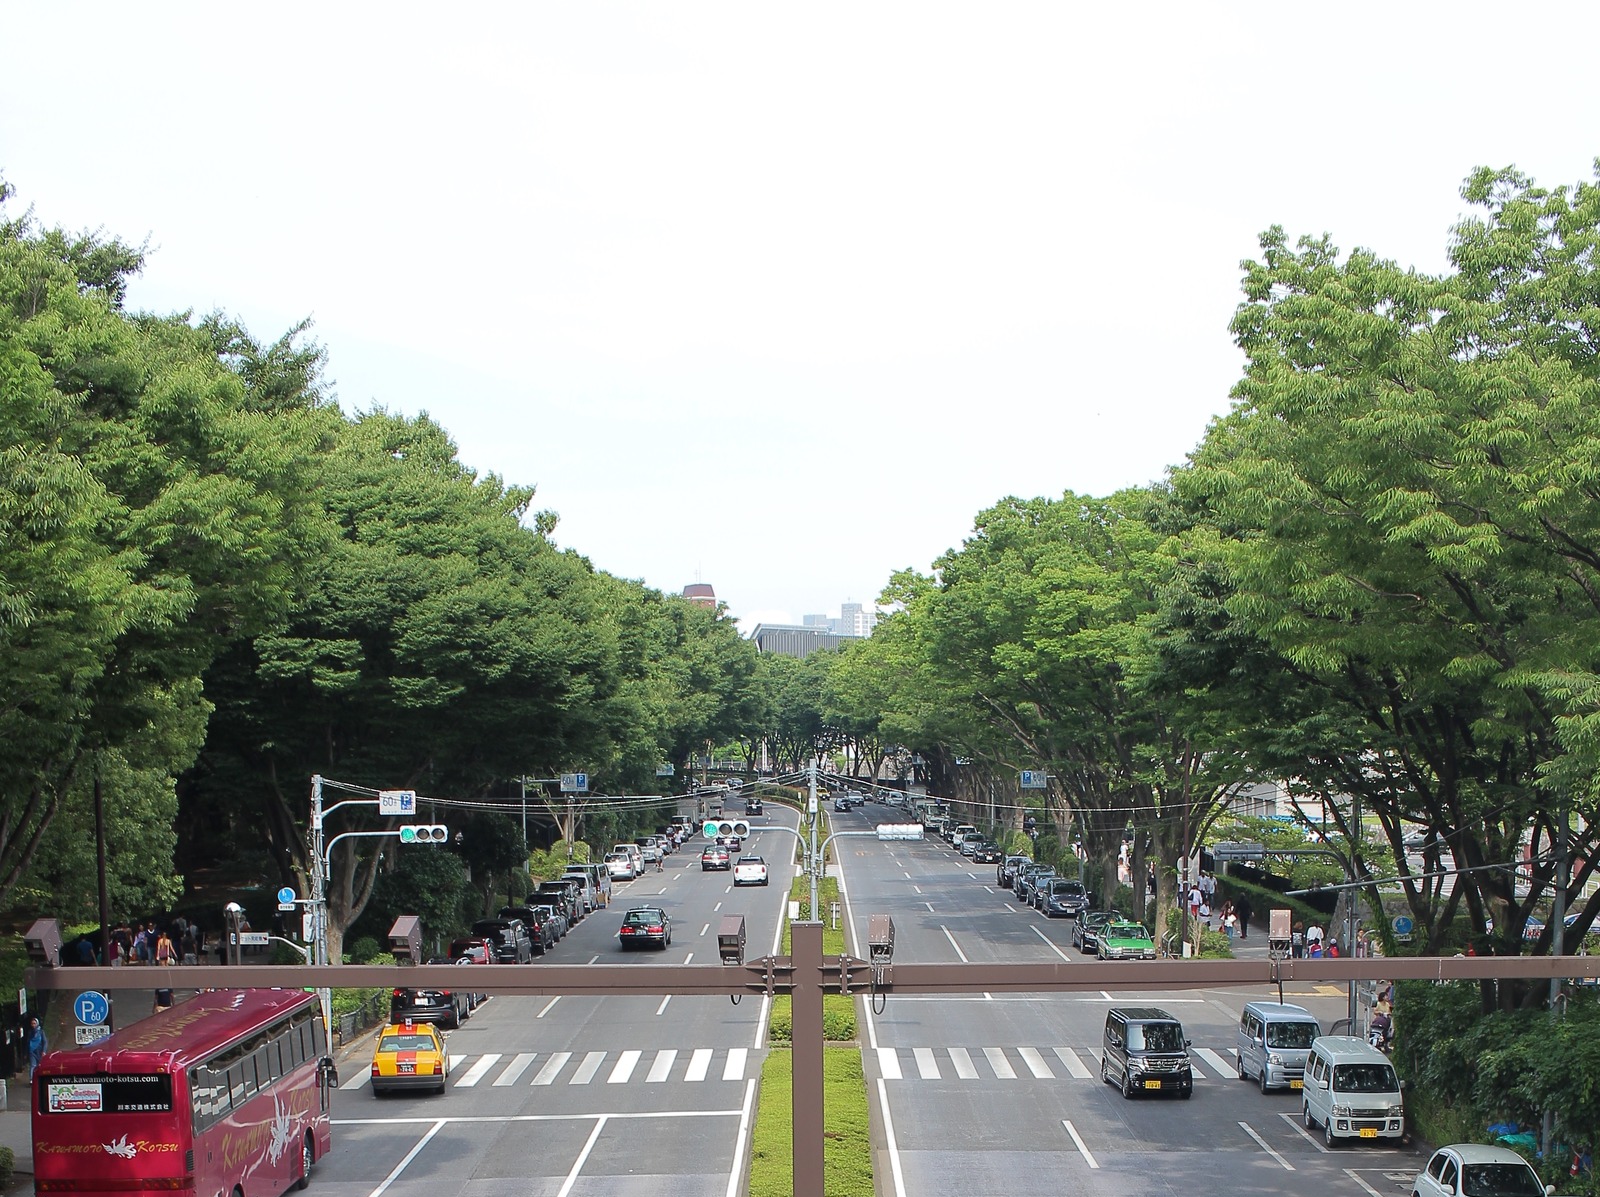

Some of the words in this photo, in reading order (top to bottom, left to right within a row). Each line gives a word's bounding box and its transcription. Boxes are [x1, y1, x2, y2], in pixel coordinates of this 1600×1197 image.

[82, 1000, 95, 1021] P
[51, 1075, 159, 1084] www.kawamoto-kotsu.com
[36, 1141, 103, 1154] KAWAMOTO
[136, 1140, 179, 1153] KOTSU
